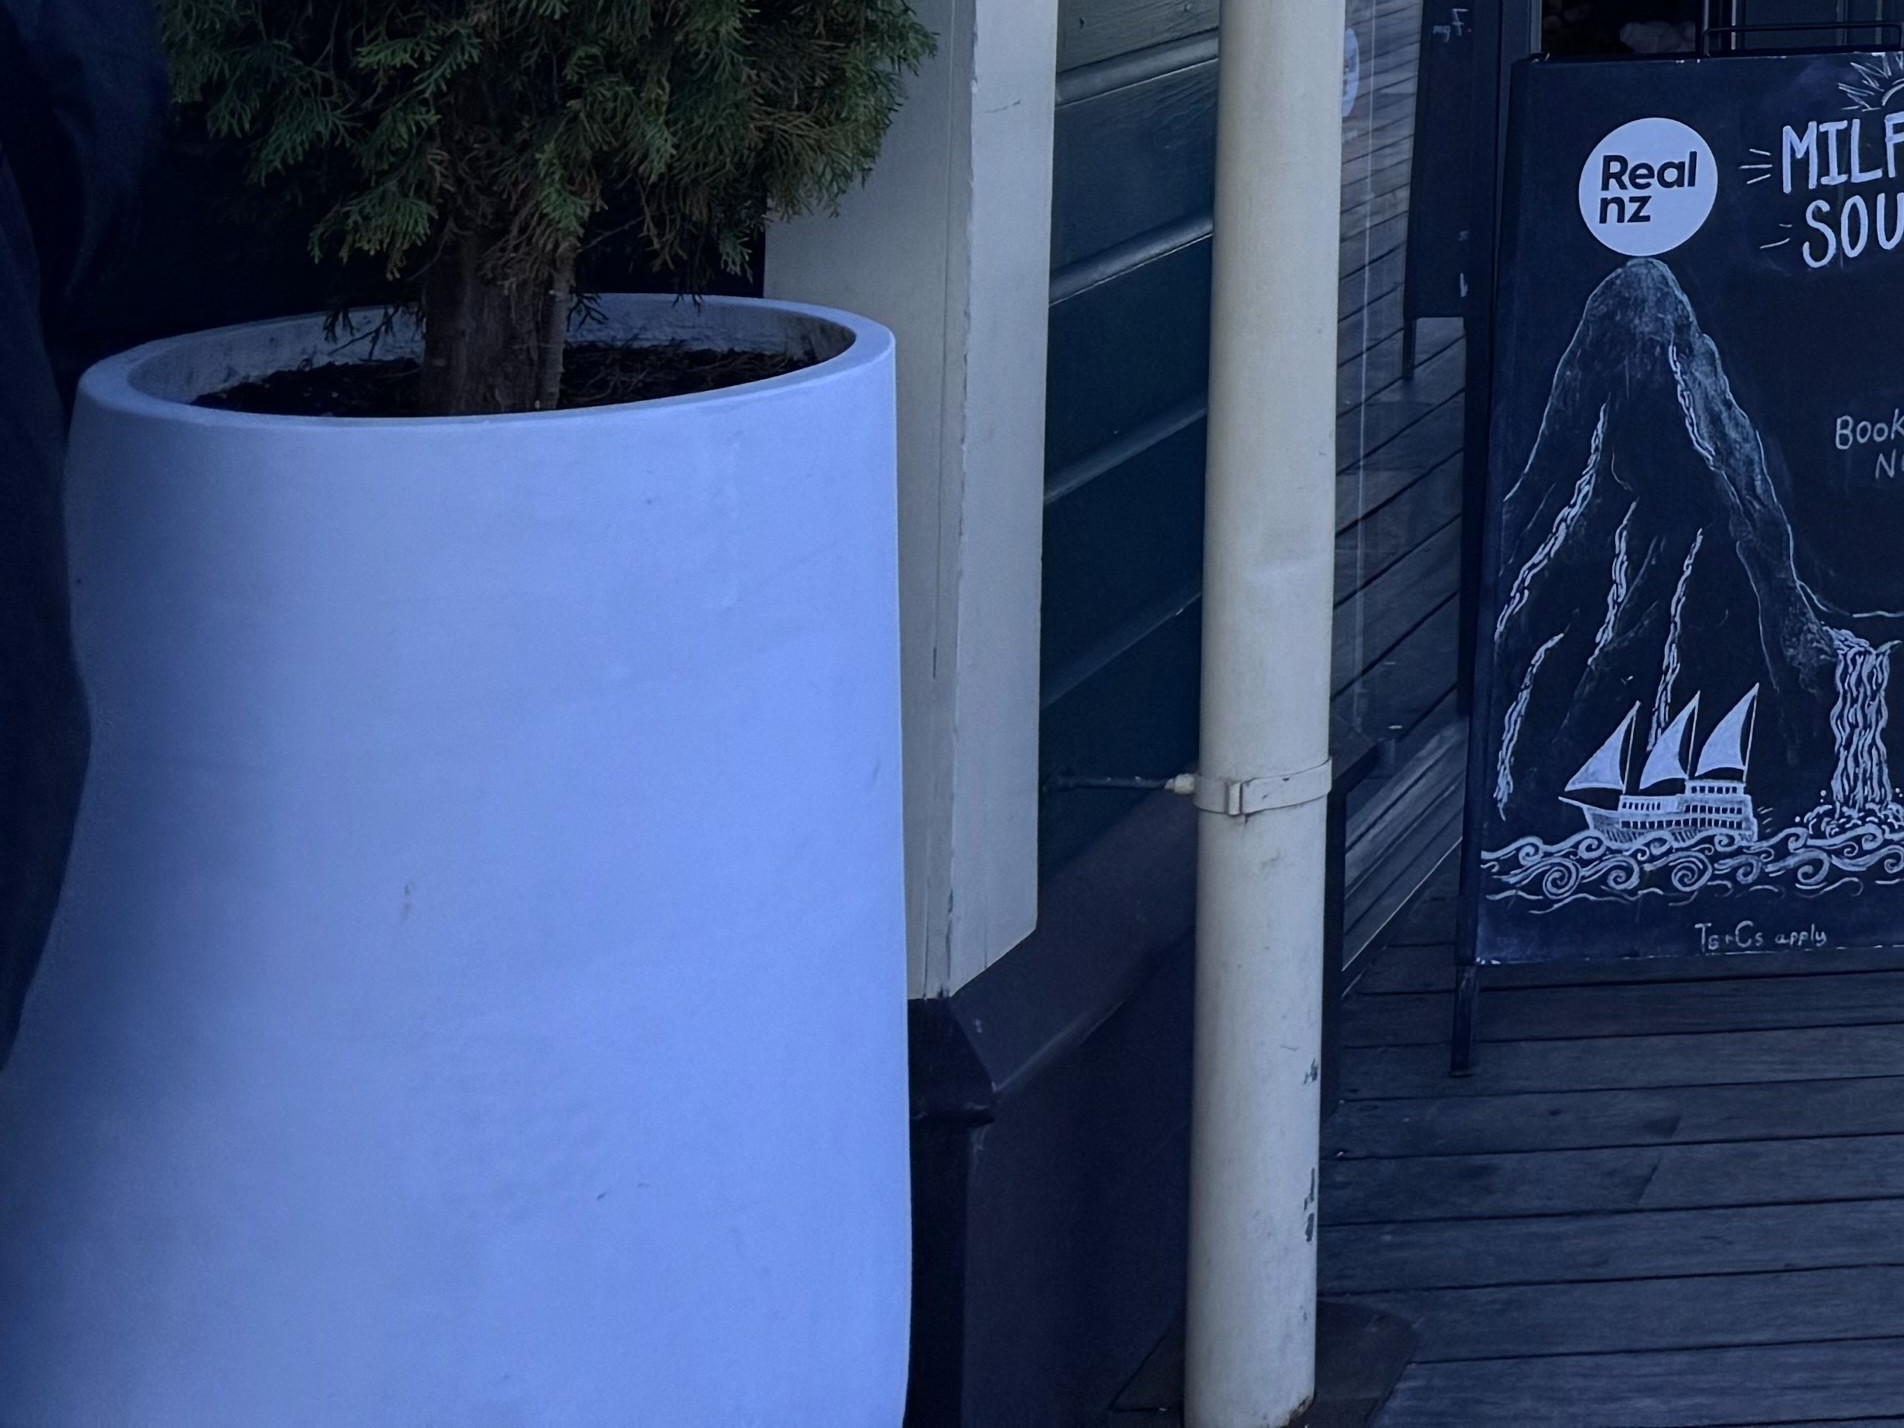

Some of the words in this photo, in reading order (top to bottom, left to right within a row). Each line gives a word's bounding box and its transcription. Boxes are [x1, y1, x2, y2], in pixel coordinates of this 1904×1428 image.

[1600, 151, 1697, 192] Real
[1600, 195, 1652, 224] nz
[1775, 923, 1827, 947] apply
